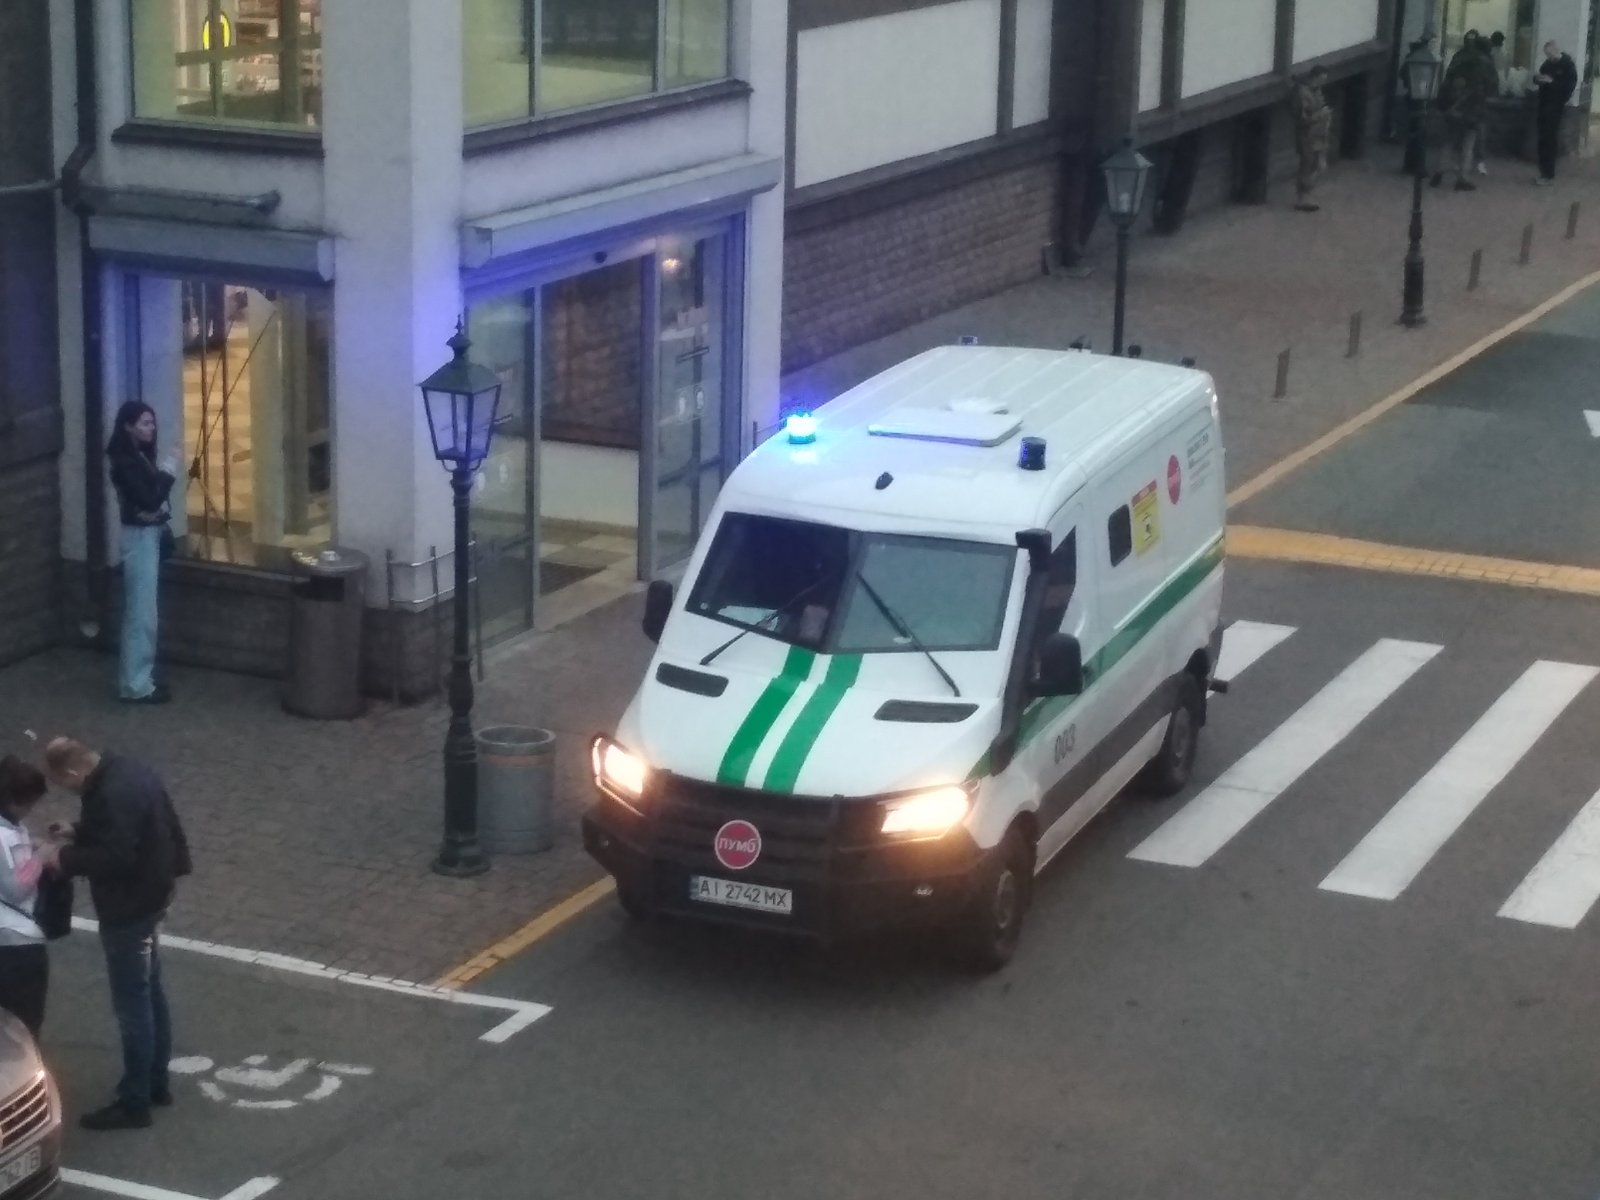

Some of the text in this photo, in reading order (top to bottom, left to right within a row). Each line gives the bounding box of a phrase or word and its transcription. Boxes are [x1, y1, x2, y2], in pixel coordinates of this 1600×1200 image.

[700, 880, 788, 907] AI 2742 MX
